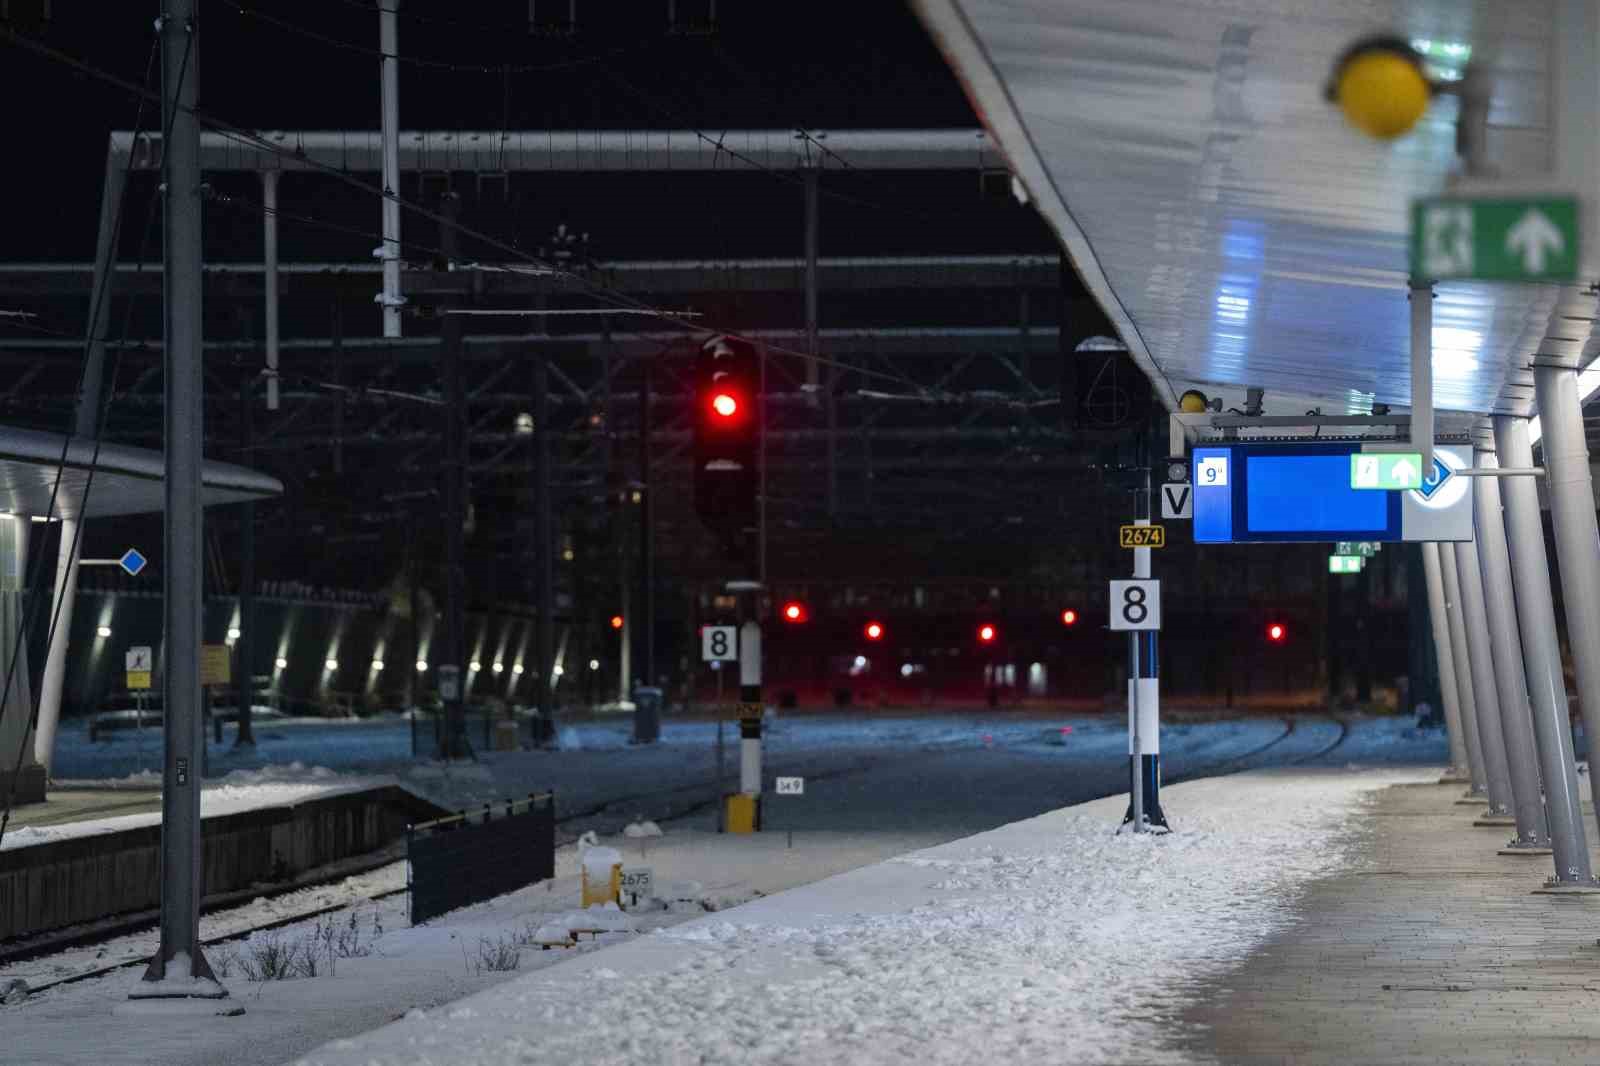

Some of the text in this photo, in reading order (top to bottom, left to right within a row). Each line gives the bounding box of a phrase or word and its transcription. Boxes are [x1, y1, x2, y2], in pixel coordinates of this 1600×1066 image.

[1165, 487, 1190, 515] V
[1124, 529, 1160, 545] 2674
[1122, 585, 1148, 624] 8
[711, 630, 728, 656] 8
